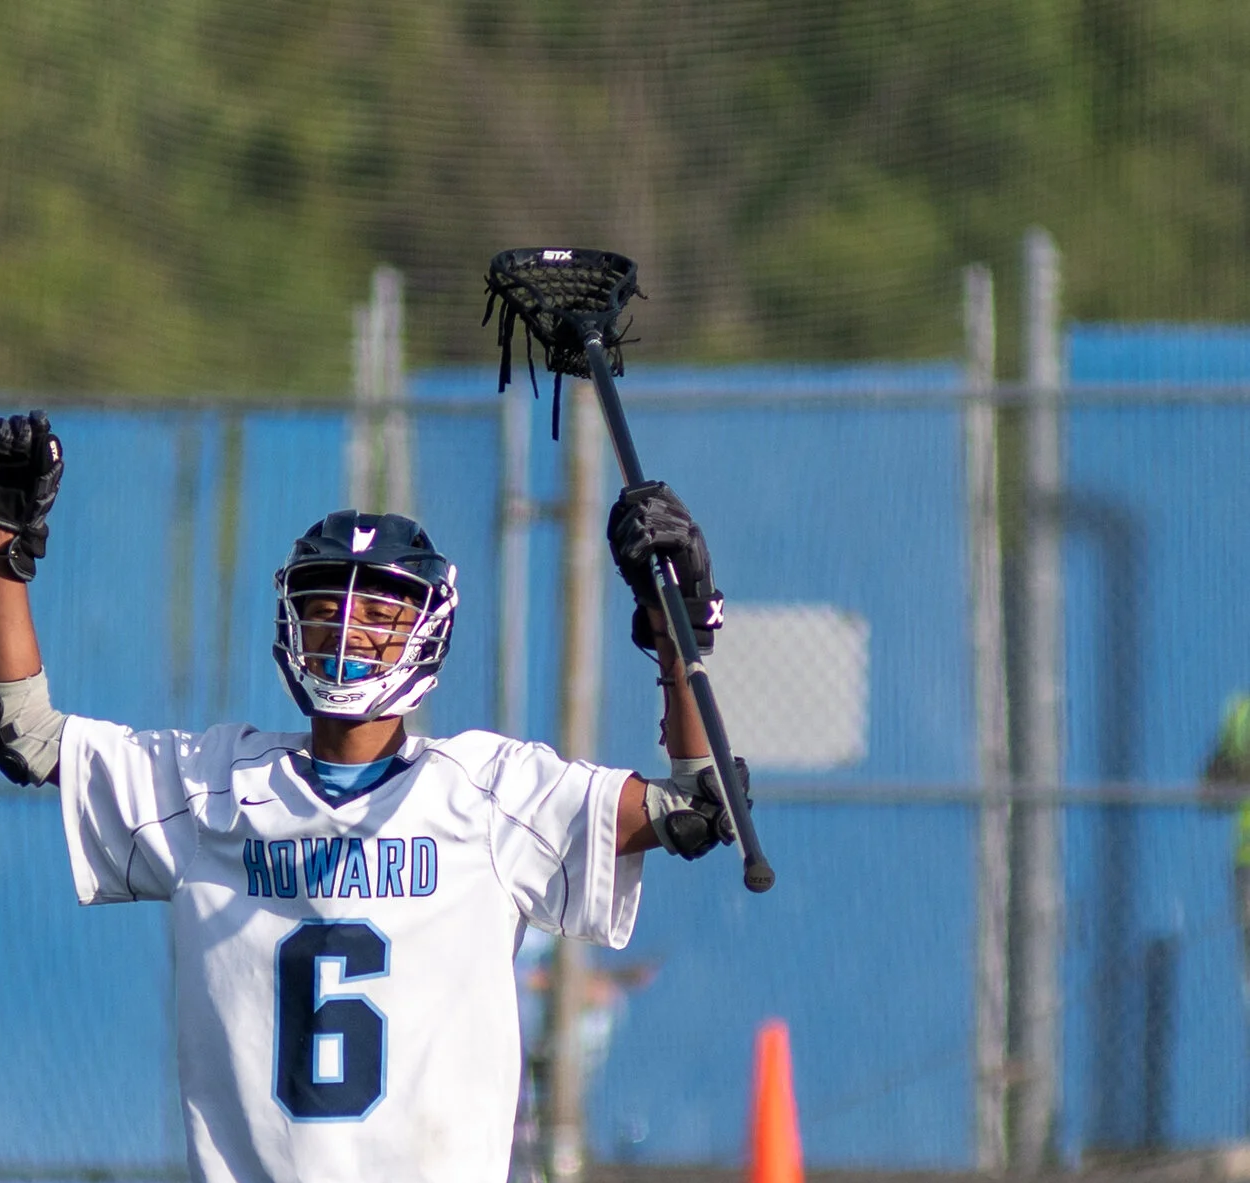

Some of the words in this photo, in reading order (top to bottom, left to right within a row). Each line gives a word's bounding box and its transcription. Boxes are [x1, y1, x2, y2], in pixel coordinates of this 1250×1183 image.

[542, 250, 572, 260] STX
[243, 836, 438, 899] HOWARD
[270, 917, 392, 1124] 6
